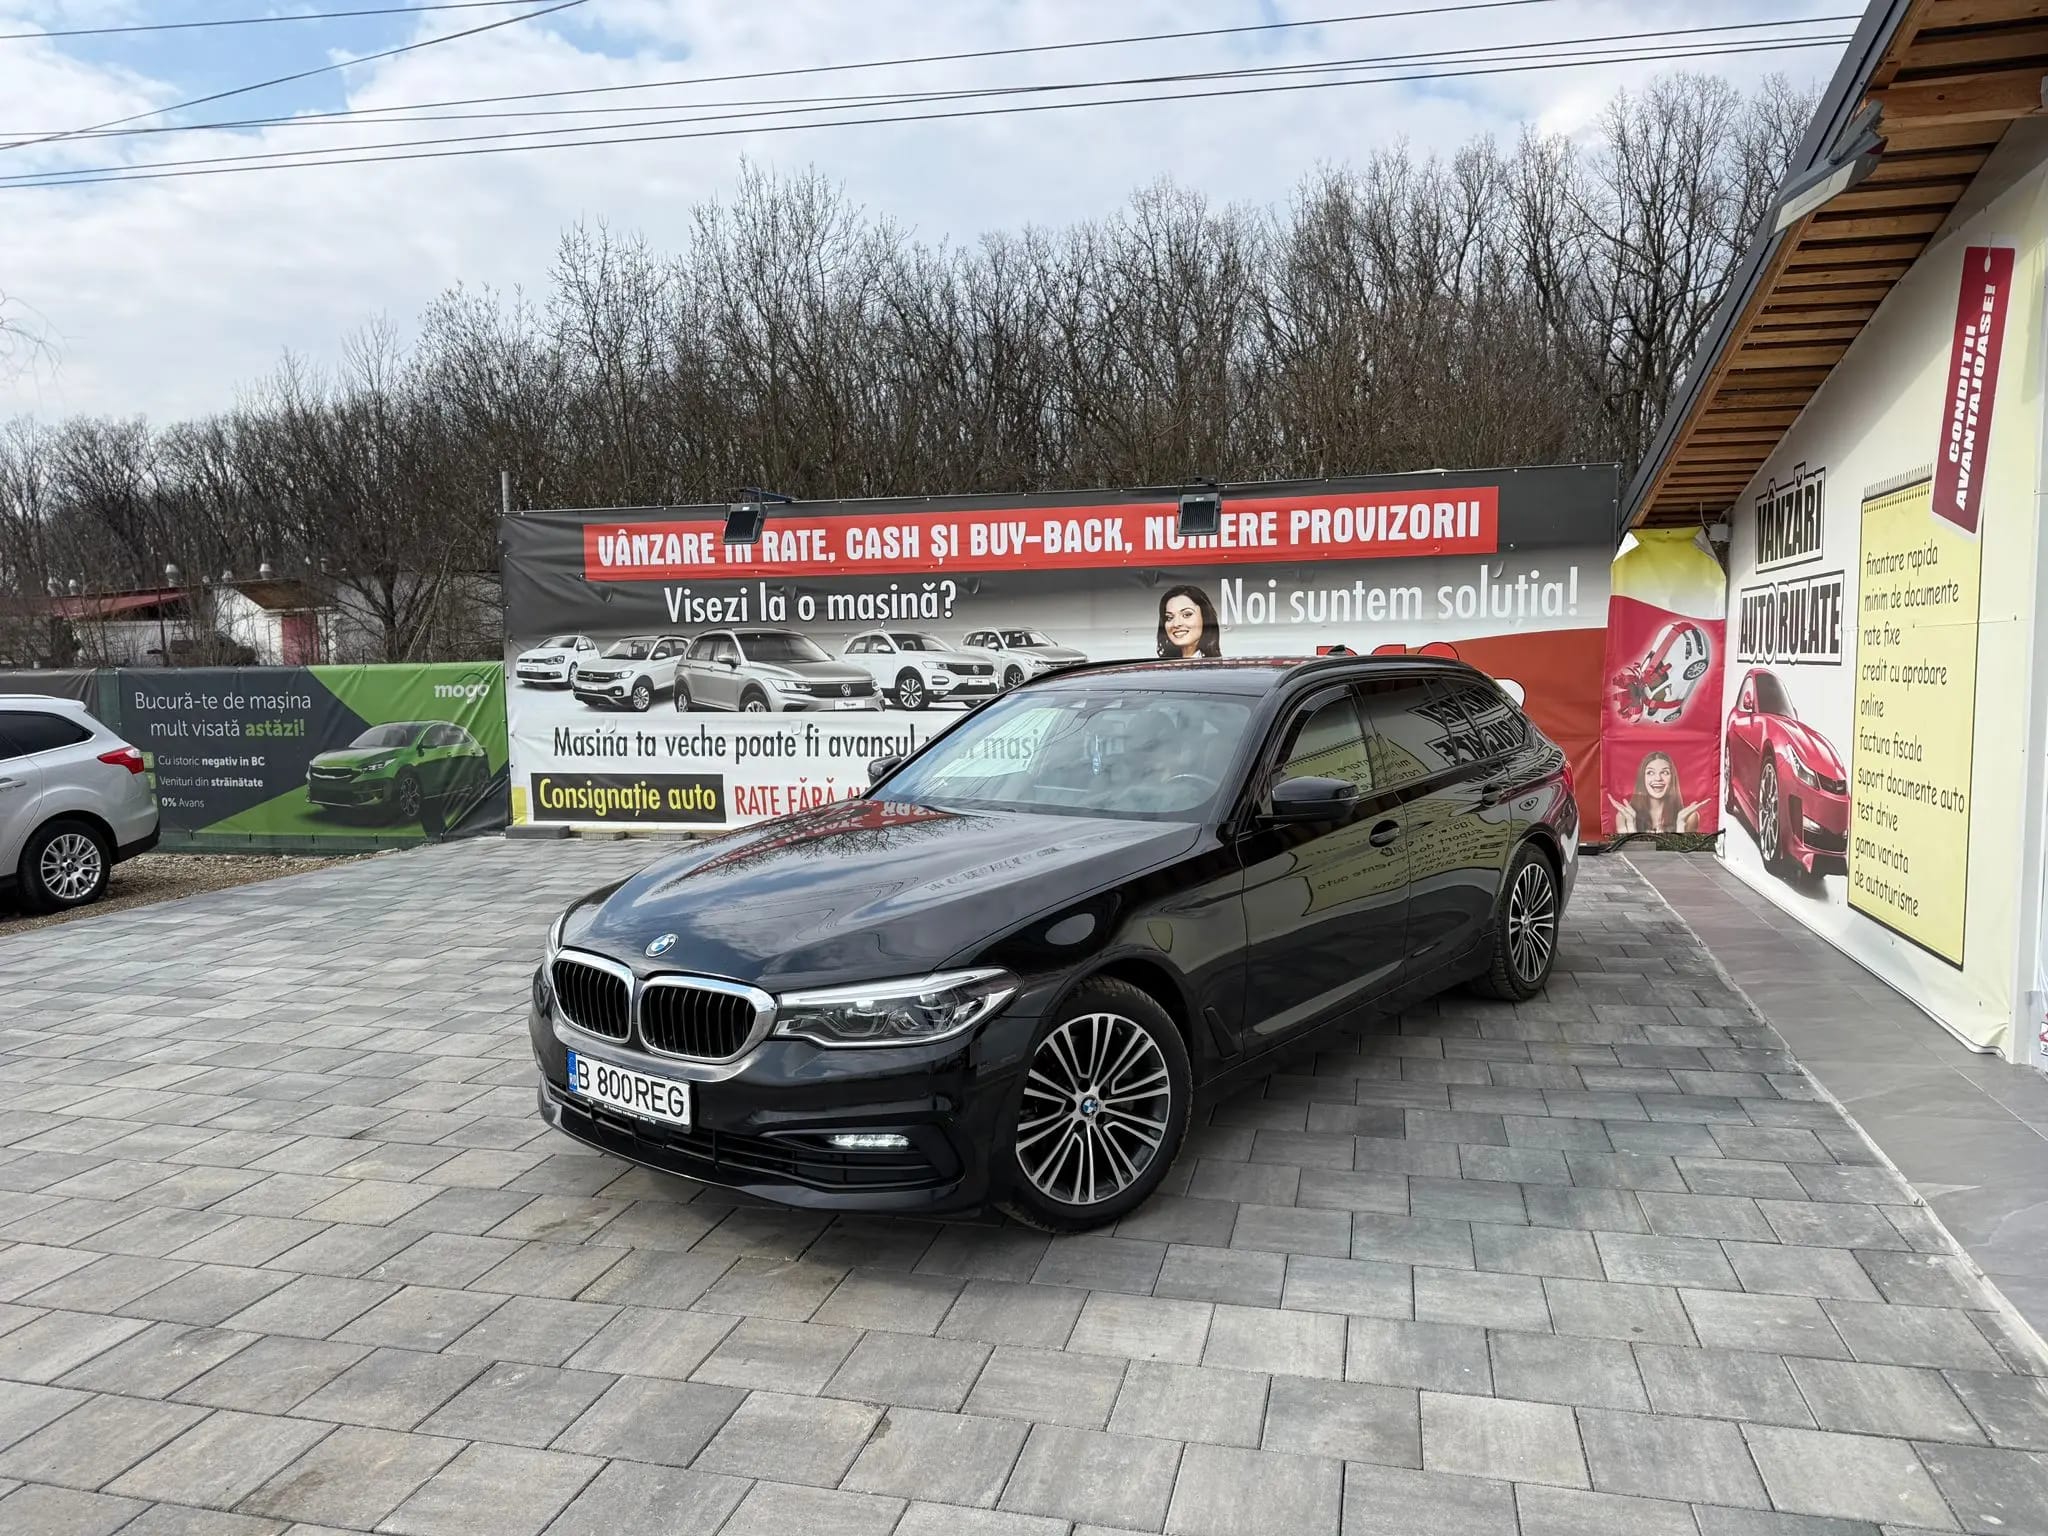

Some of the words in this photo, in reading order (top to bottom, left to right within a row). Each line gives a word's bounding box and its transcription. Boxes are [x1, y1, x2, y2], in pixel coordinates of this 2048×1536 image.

[598, 529, 715, 566] VÂNZARE
[762, 529, 836, 562] RATE,
[846, 525, 920, 560] CASH
[930, 523, 958, 565] ȘI
[970, 518, 1133, 557] BUY-BACK,
[1290, 501, 1480, 545] PROVIZORII
[1757, 474, 1823, 565] VÂNZĂRI
[1866, 552, 1904, 577] finantare
[1907, 538, 1938, 576] rapida
[664, 587, 749, 623] Visezi
[760, 582, 786, 622] la
[798, 595, 816, 621] o
[827, 580, 957, 627] mașină?
[1221, 578, 1277, 625] Noi
[1290, 580, 1422, 623] suntem
[1864, 587, 1888, 612] minim
[1890, 584, 1901, 608] de
[1904, 578, 1959, 608] documente
[1739, 592, 1775, 655] AUTO
[1777, 582, 1841, 655] RULATE
[1863, 625, 1881, 646] rate
[1884, 621, 1901, 647] fixe
[1862, 657, 1888, 682] credit
[1890, 665, 1900, 683] cu
[1902, 658, 1947, 691] aprobare
[135, 692, 218, 709] Bucură-te
[223, 692, 245, 709] de
[250, 692, 311, 713] mașina
[434, 684, 490, 704] mogo
[1860, 692, 1884, 718] online
[150, 720, 188, 737] mult
[192, 719, 240, 737] visată
[245, 719, 305, 737] astăzi!
[636, 731, 656, 756] ta
[665, 724, 726, 757] veche
[735, 731, 796, 764] poate
[805, 724, 819, 757] fi
[829, 723, 914, 757] avansul
[1859, 726, 1890, 755] factura
[1893, 731, 1922, 762] fiscala
[158, 755, 171, 766] Cu
[173, 755, 200, 766] istoric
[202, 756, 238, 768] negativ
[251, 756, 265, 766] BC
[160, 776, 193, 786] Venituri
[195, 777, 209, 786] din
[211, 777, 264, 787] străinătate
[539, 778, 661, 817] Consignație
[668, 784, 716, 810] auto
[1858, 767, 1884, 793] suport
[1887, 768, 1938, 805] documente
[1940, 786, 1965, 813] auto
[162, 797, 177, 807] 0%
[178, 798, 205, 808] Avans
[734, 786, 781, 815] RATE
[1857, 798, 1873, 823] test
[1876, 802, 1898, 831] drive
[1855, 837, 1875, 859] gama
[1878, 844, 1909, 874] variata
[1854, 864, 1864, 888] de
[1866, 875, 1919, 917] autoturisme
[577, 1059, 590, 1090] B
